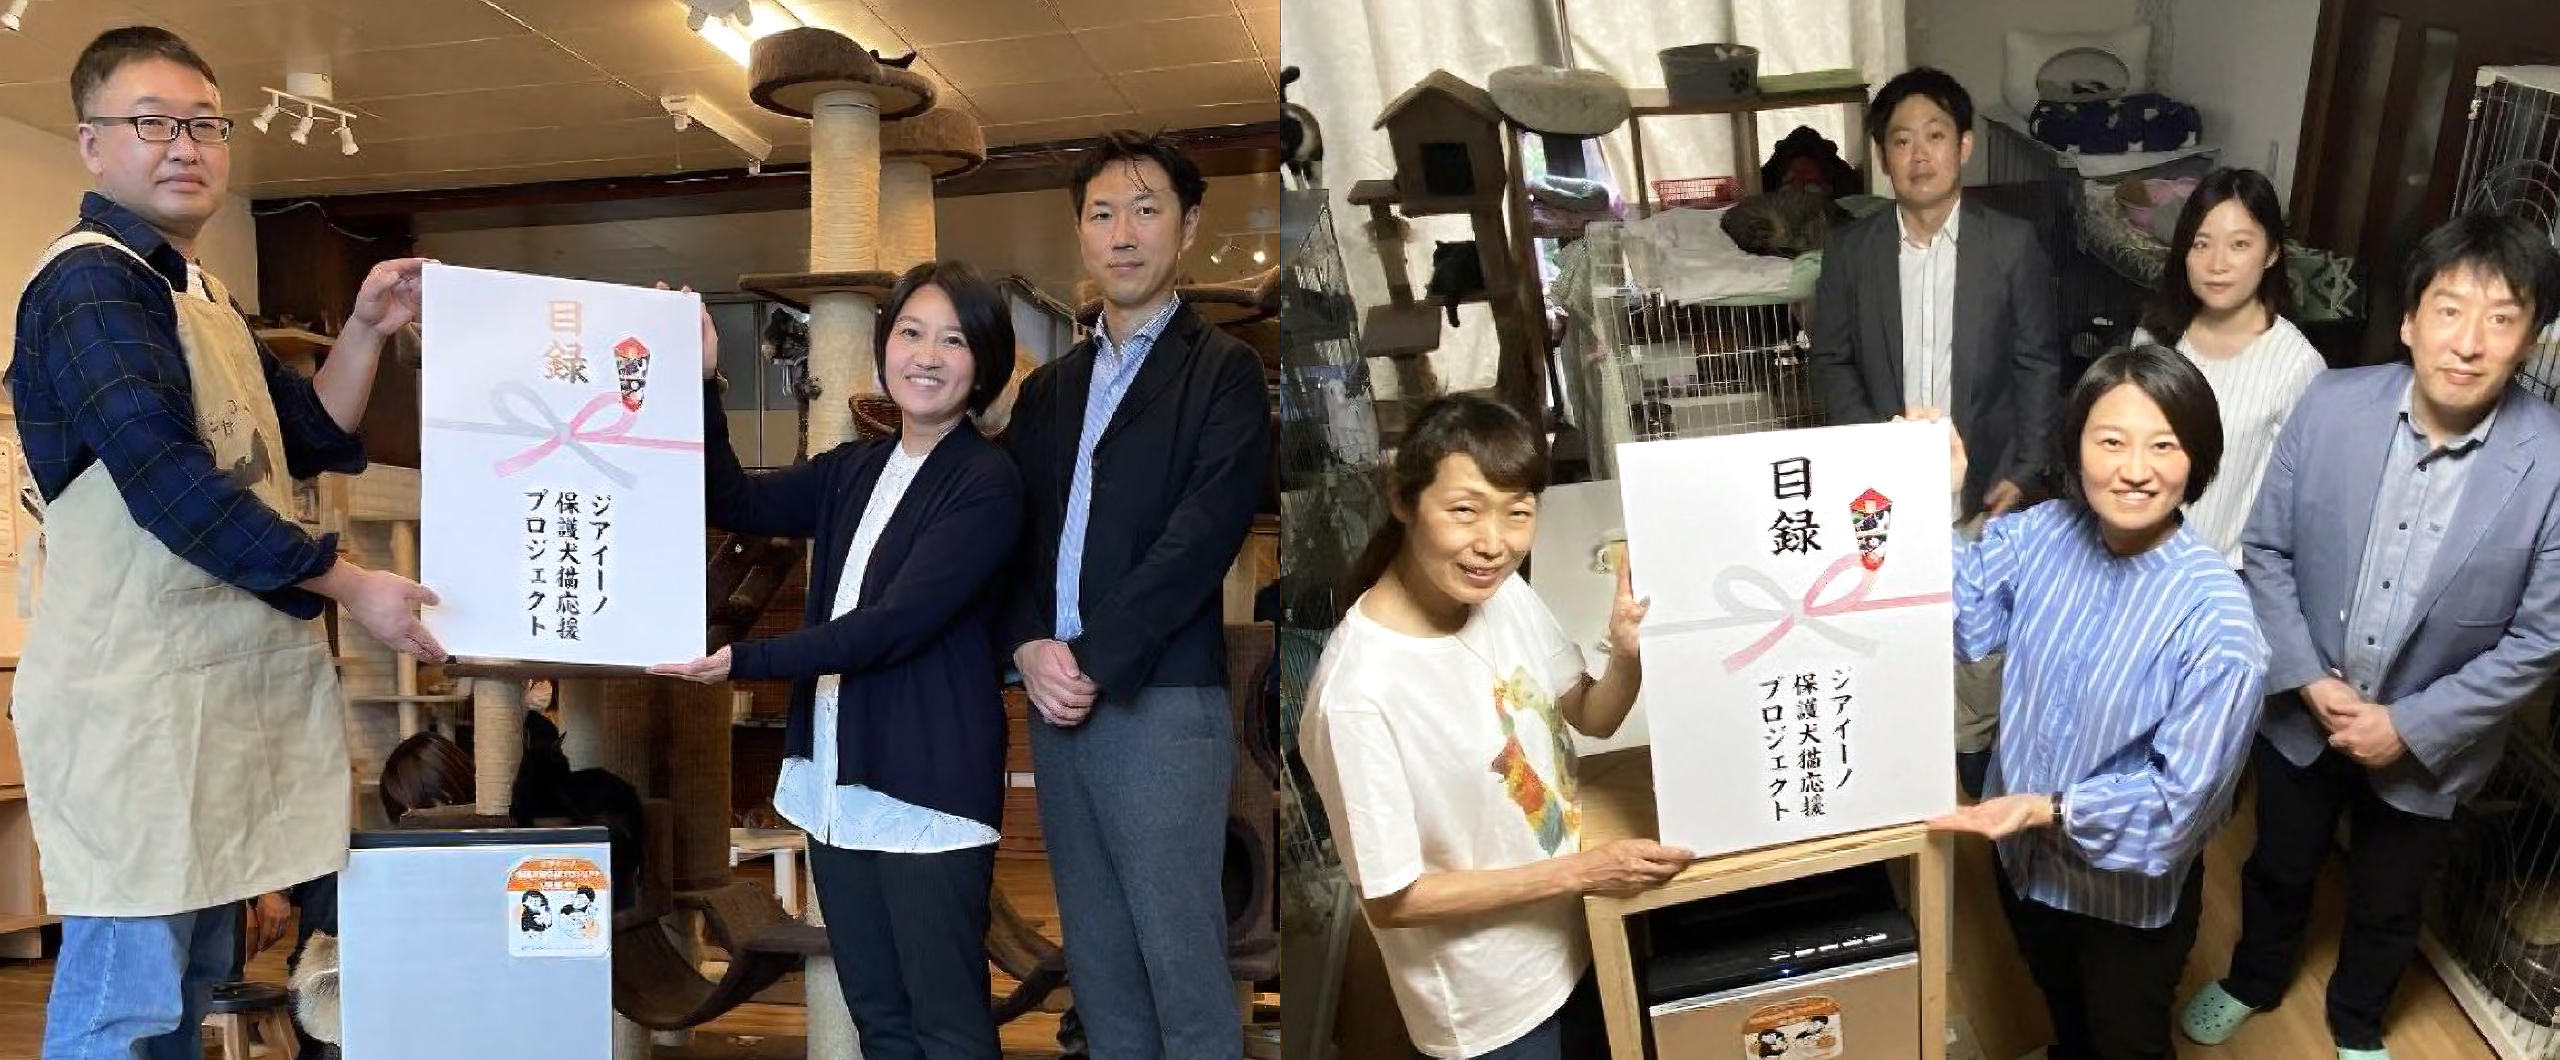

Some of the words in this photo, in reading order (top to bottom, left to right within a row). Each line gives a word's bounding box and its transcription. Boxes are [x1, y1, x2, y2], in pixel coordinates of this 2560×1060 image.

[547, 300, 590, 383] 目録
[523, 489, 548, 637] プロジェクト
[555, 491, 582, 641] 保護犬猫応援
[590, 494, 611, 616] ジアイーノ
[1768, 456, 1821, 556] 目録
[1758, 676, 1789, 822] プロジェクト
[1794, 673, 1828, 818] 保護犬猫応援
[1832, 667, 1854, 790] ジアイーノ
